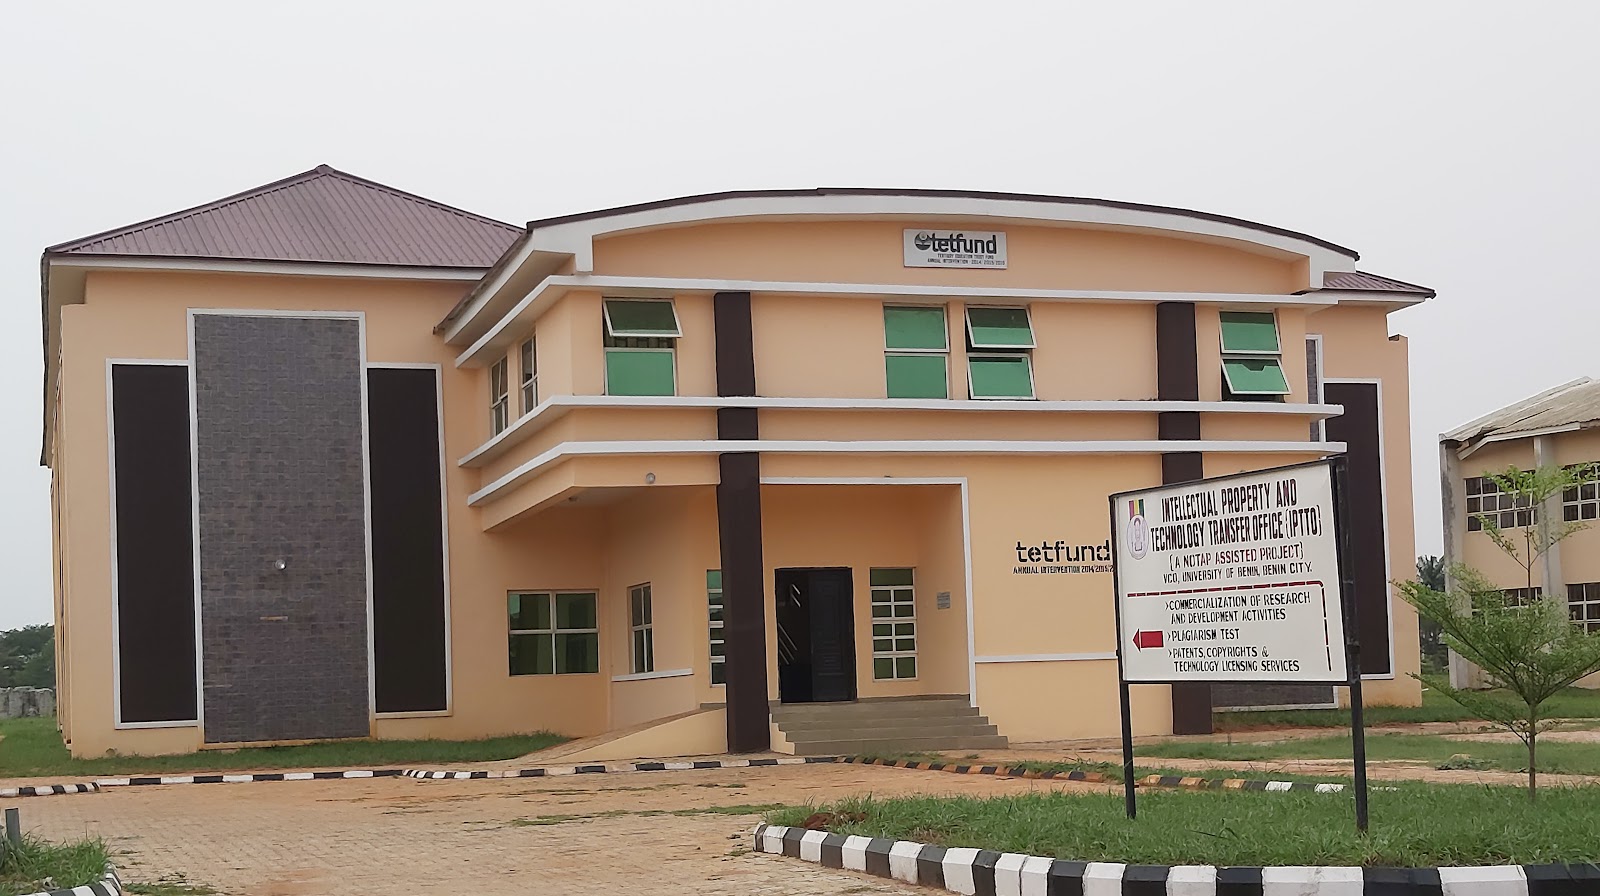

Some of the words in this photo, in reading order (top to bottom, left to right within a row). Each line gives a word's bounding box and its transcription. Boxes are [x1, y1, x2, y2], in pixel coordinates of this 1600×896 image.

[930, 232, 997, 254] tetfund
[1161, 490, 1218, 523] INTELLECTUAL
[1221, 483, 1271, 515] PROPERTY
[1276, 478, 1297, 508] AND
[1150, 521, 1205, 552] TECHNOLOGY
[1208, 515, 1251, 546] TRANSFER
[1252, 511, 1284, 541] OFFICE
[1015, 539, 1111, 563] tetfund
[1183, 552, 1212, 569] NOTAP
[1215, 548, 1257, 566] ASSISTED
[1260, 541, 1304, 561] PROJECT)
[1013, 565, 1039, 575] ANNUAL
[1040, 565, 1081, 574] INTERVENTION
[1182, 568, 1222, 583] UNIVERSITY
[1225, 567, 1234, 579] OF
[1237, 565, 1261, 578] BENIN,
[1262, 563, 1287, 576] BENIN
[1289, 561, 1313, 574] CITY.
[1250, 594, 1261, 607] OF
[1263, 591, 1311, 606] RESEARCH
[1171, 611, 1186, 624] AND
[1188, 610, 1238, 623] DEVELOPMENT
[1241, 608, 1286, 622] ACTIVITIES
[1171, 629, 1217, 642] PLAGIARISM
[1220, 628, 1240, 640] TEST
[1261, 645, 1270, 658] &
[1173, 660, 1219, 673] TECHNOLOGY
[1221, 660, 1258, 672] LICENSING
[1260, 659, 1300, 672] SERVICES
